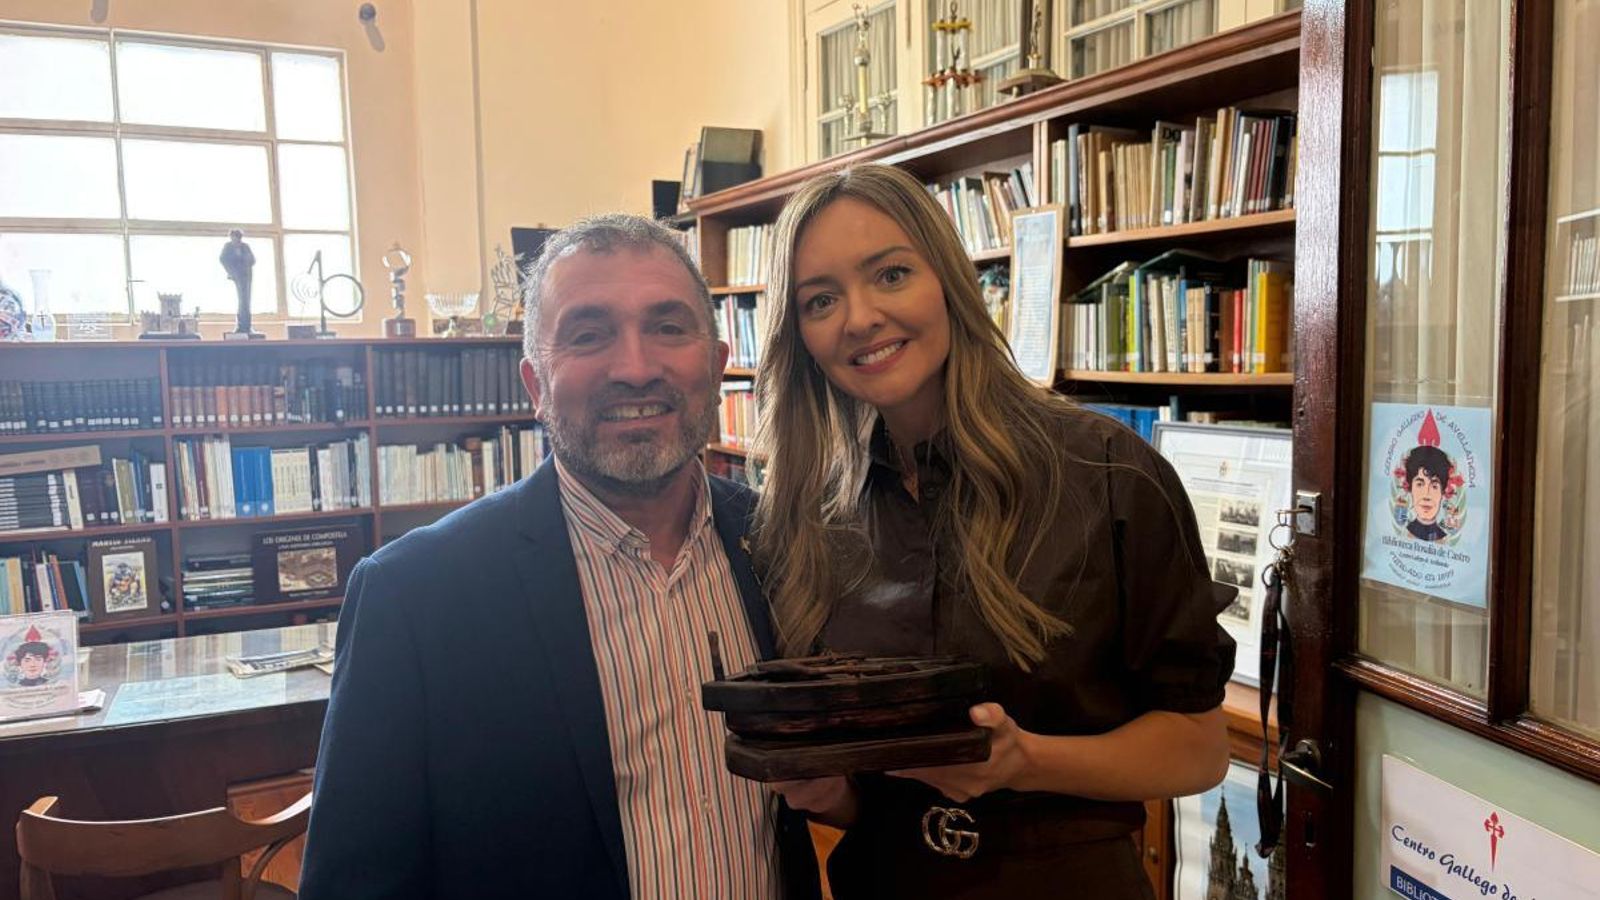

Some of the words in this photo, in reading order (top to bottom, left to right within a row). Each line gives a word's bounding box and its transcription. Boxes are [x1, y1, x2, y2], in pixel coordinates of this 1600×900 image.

[1447, 549, 1471, 564] Castro
[1391, 825, 1436, 860] Centro
[1439, 854, 1497, 895] Gallego
